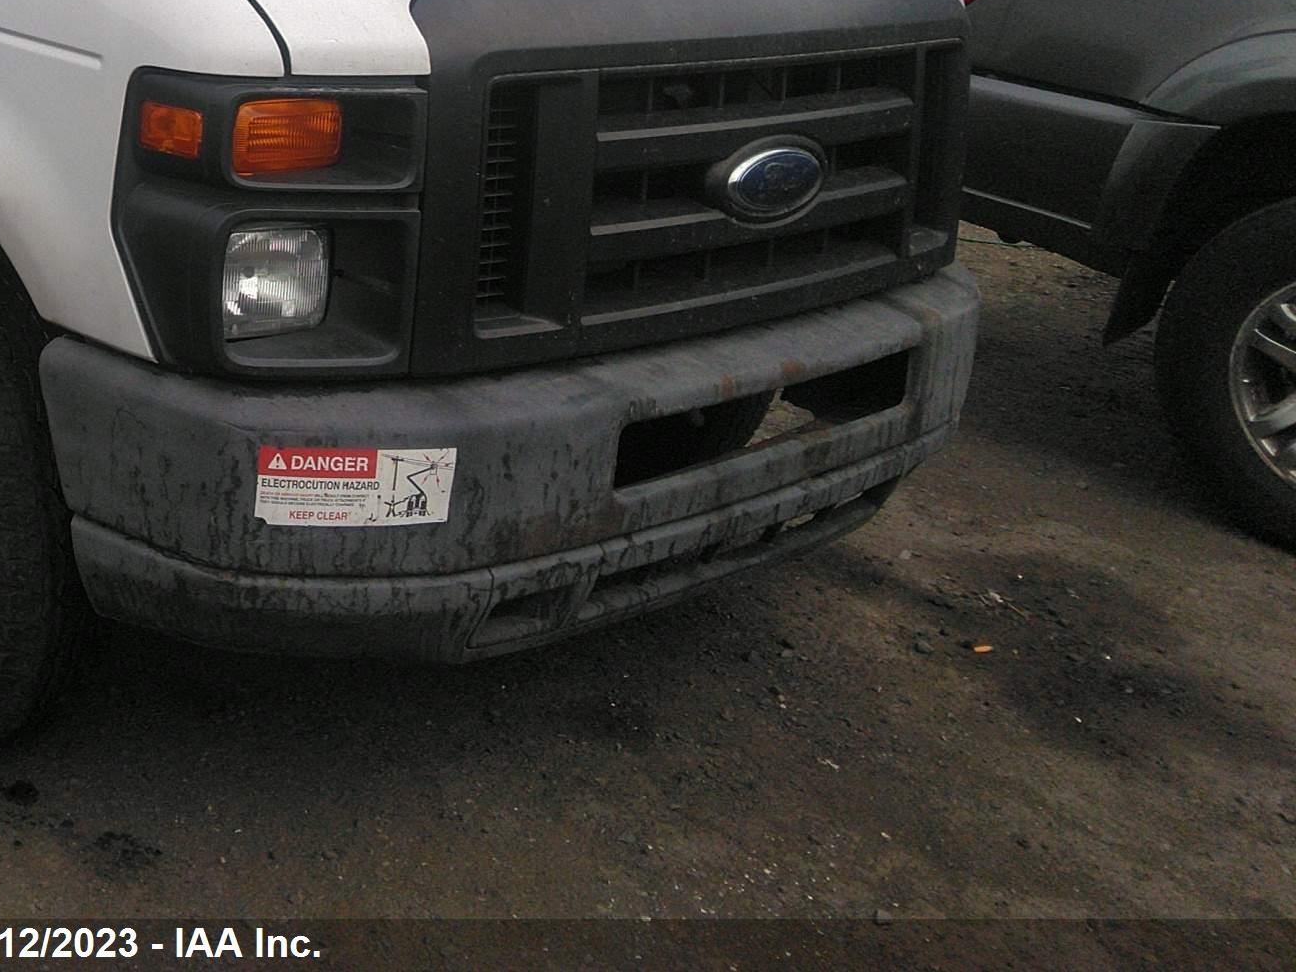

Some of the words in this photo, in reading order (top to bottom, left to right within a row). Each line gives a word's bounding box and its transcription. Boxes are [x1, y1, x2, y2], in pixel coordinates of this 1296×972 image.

[291, 455, 369, 472] DANGER
[261, 479, 340, 490] ELECTROCUTION
[342, 481, 380, 491] HAZARD
[289, 511, 314, 520] KEEP
[316, 511, 348, 521] CLEAR
